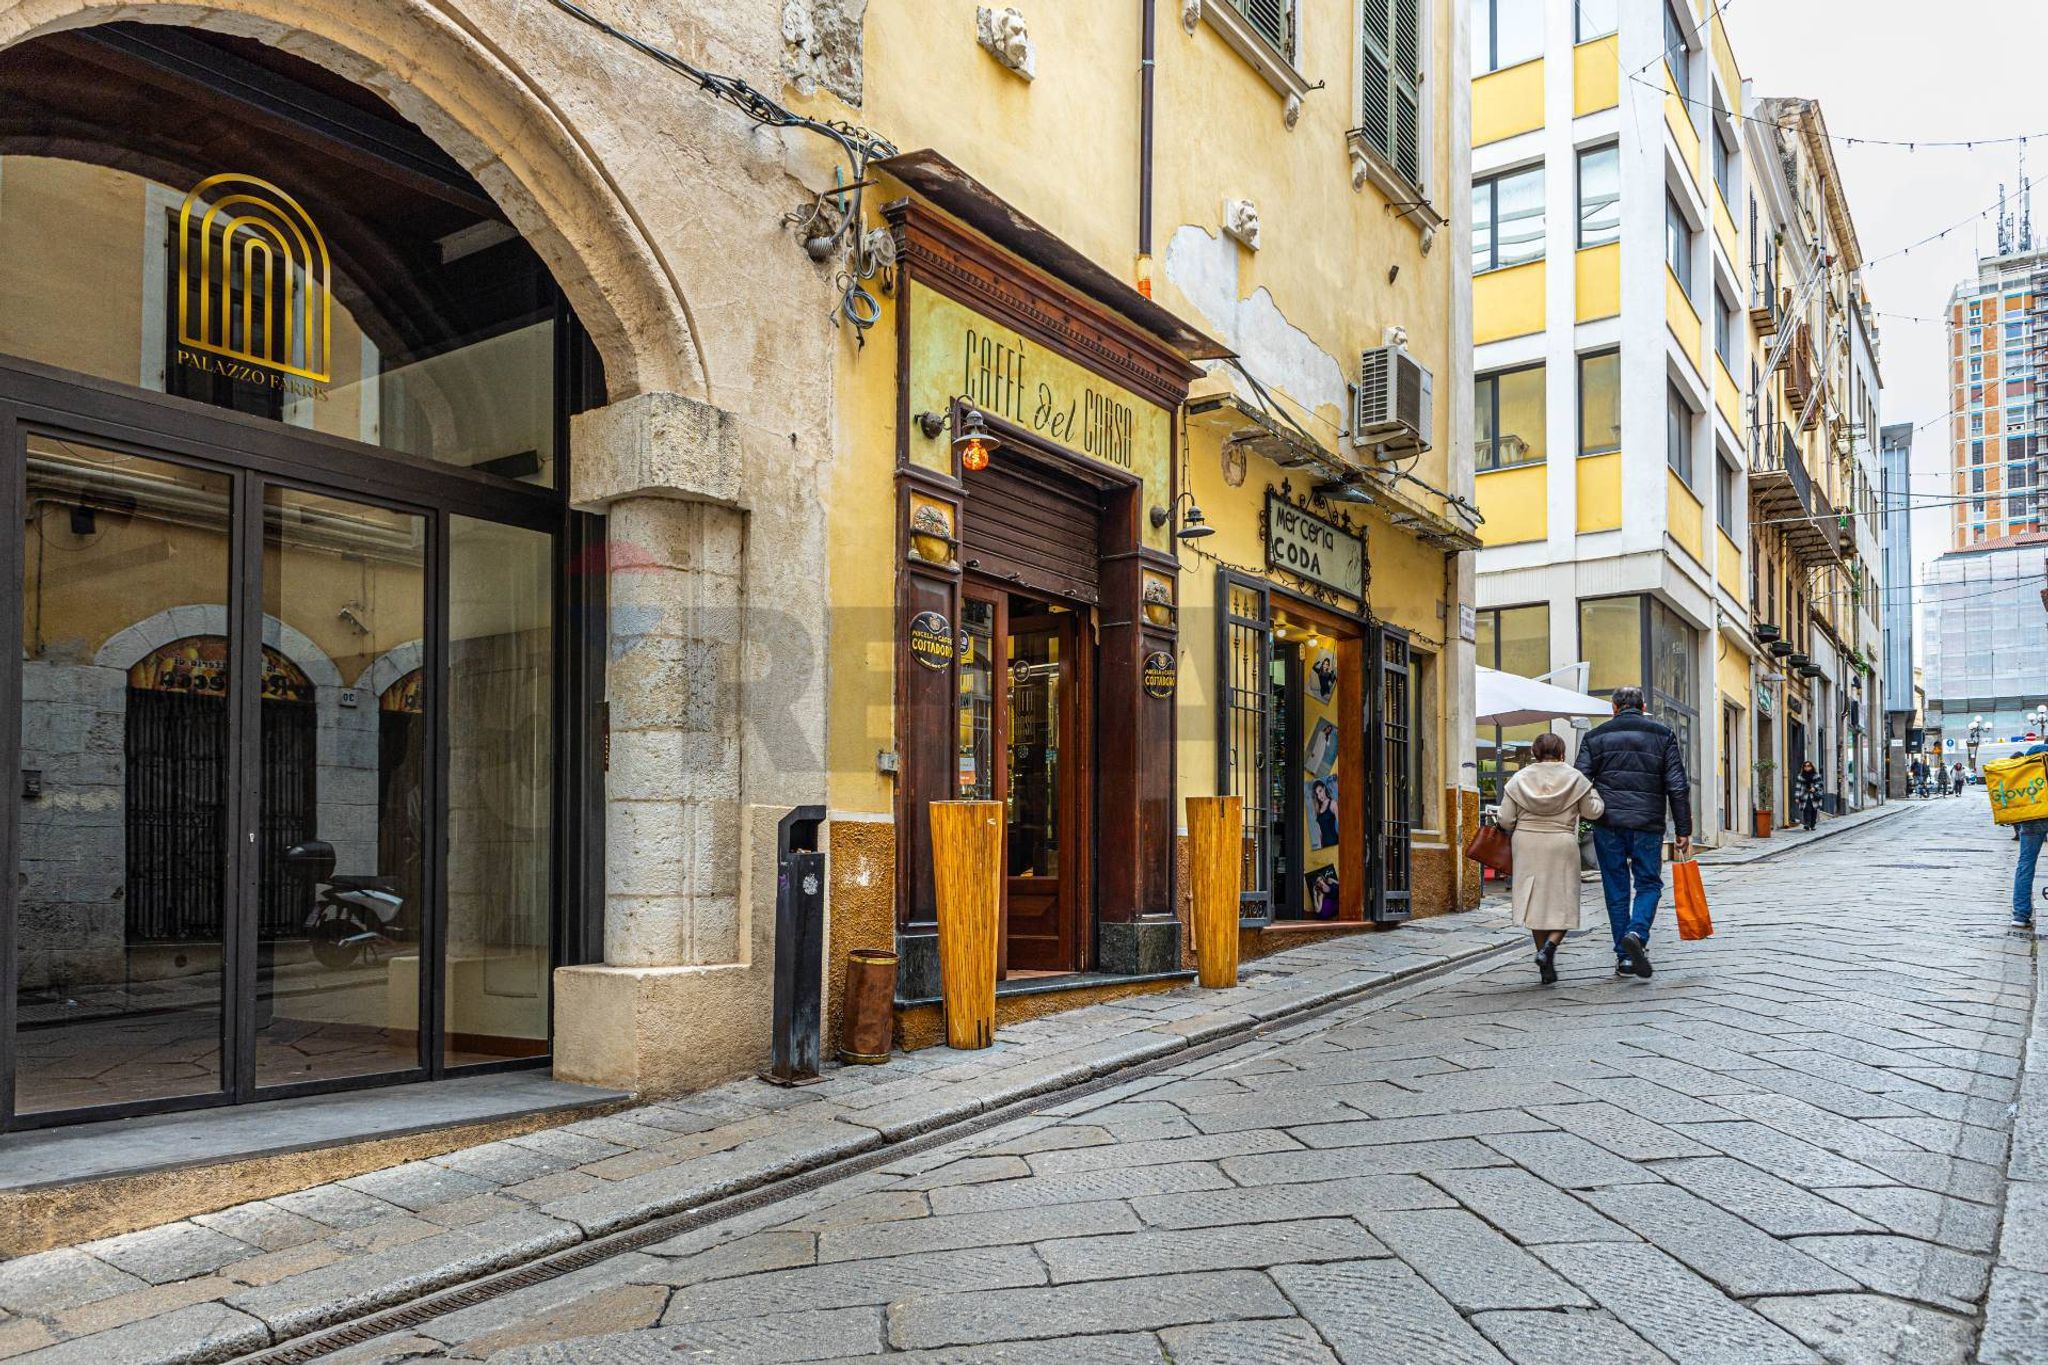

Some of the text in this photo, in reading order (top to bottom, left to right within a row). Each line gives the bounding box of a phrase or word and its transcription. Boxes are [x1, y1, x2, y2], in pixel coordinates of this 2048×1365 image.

[177, 350, 329, 401] PALAZZO FARRIS
[966, 329, 1132, 468] CAFFÈ del CORSO
[1274, 537, 1321, 575] CODA
